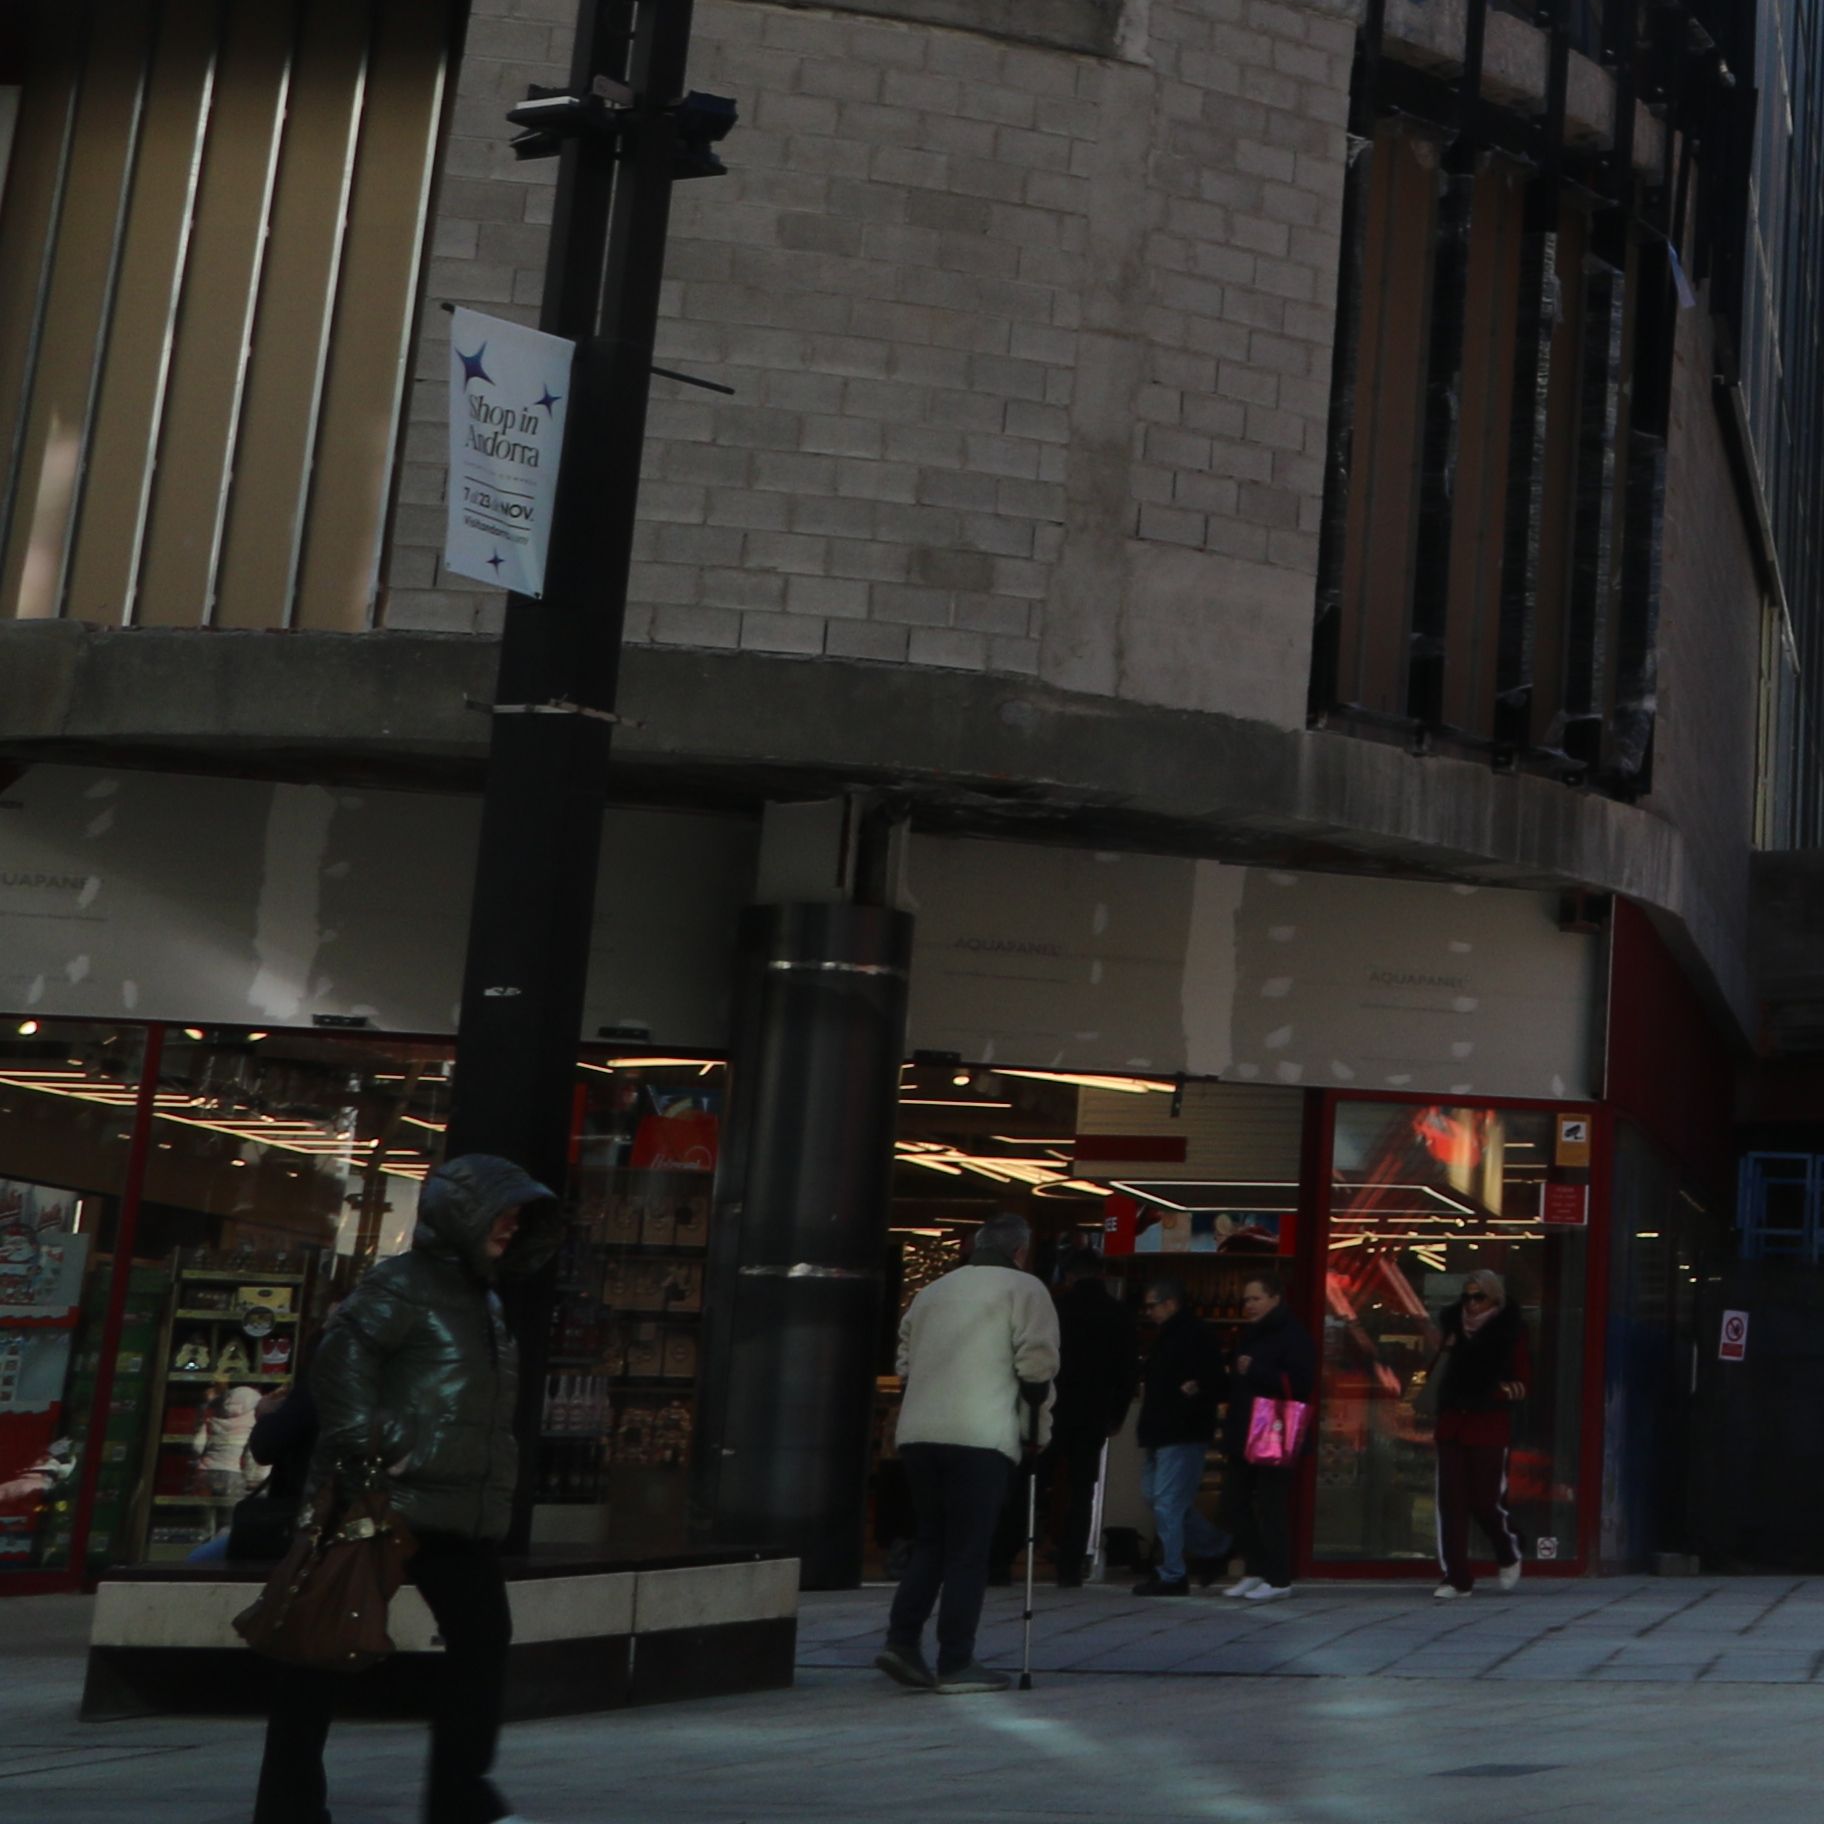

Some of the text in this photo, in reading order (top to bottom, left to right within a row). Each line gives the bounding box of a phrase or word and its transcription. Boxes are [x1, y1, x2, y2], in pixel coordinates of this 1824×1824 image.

[468, 393, 540, 436] Shop in
[465, 424, 540, 467] Andorra
